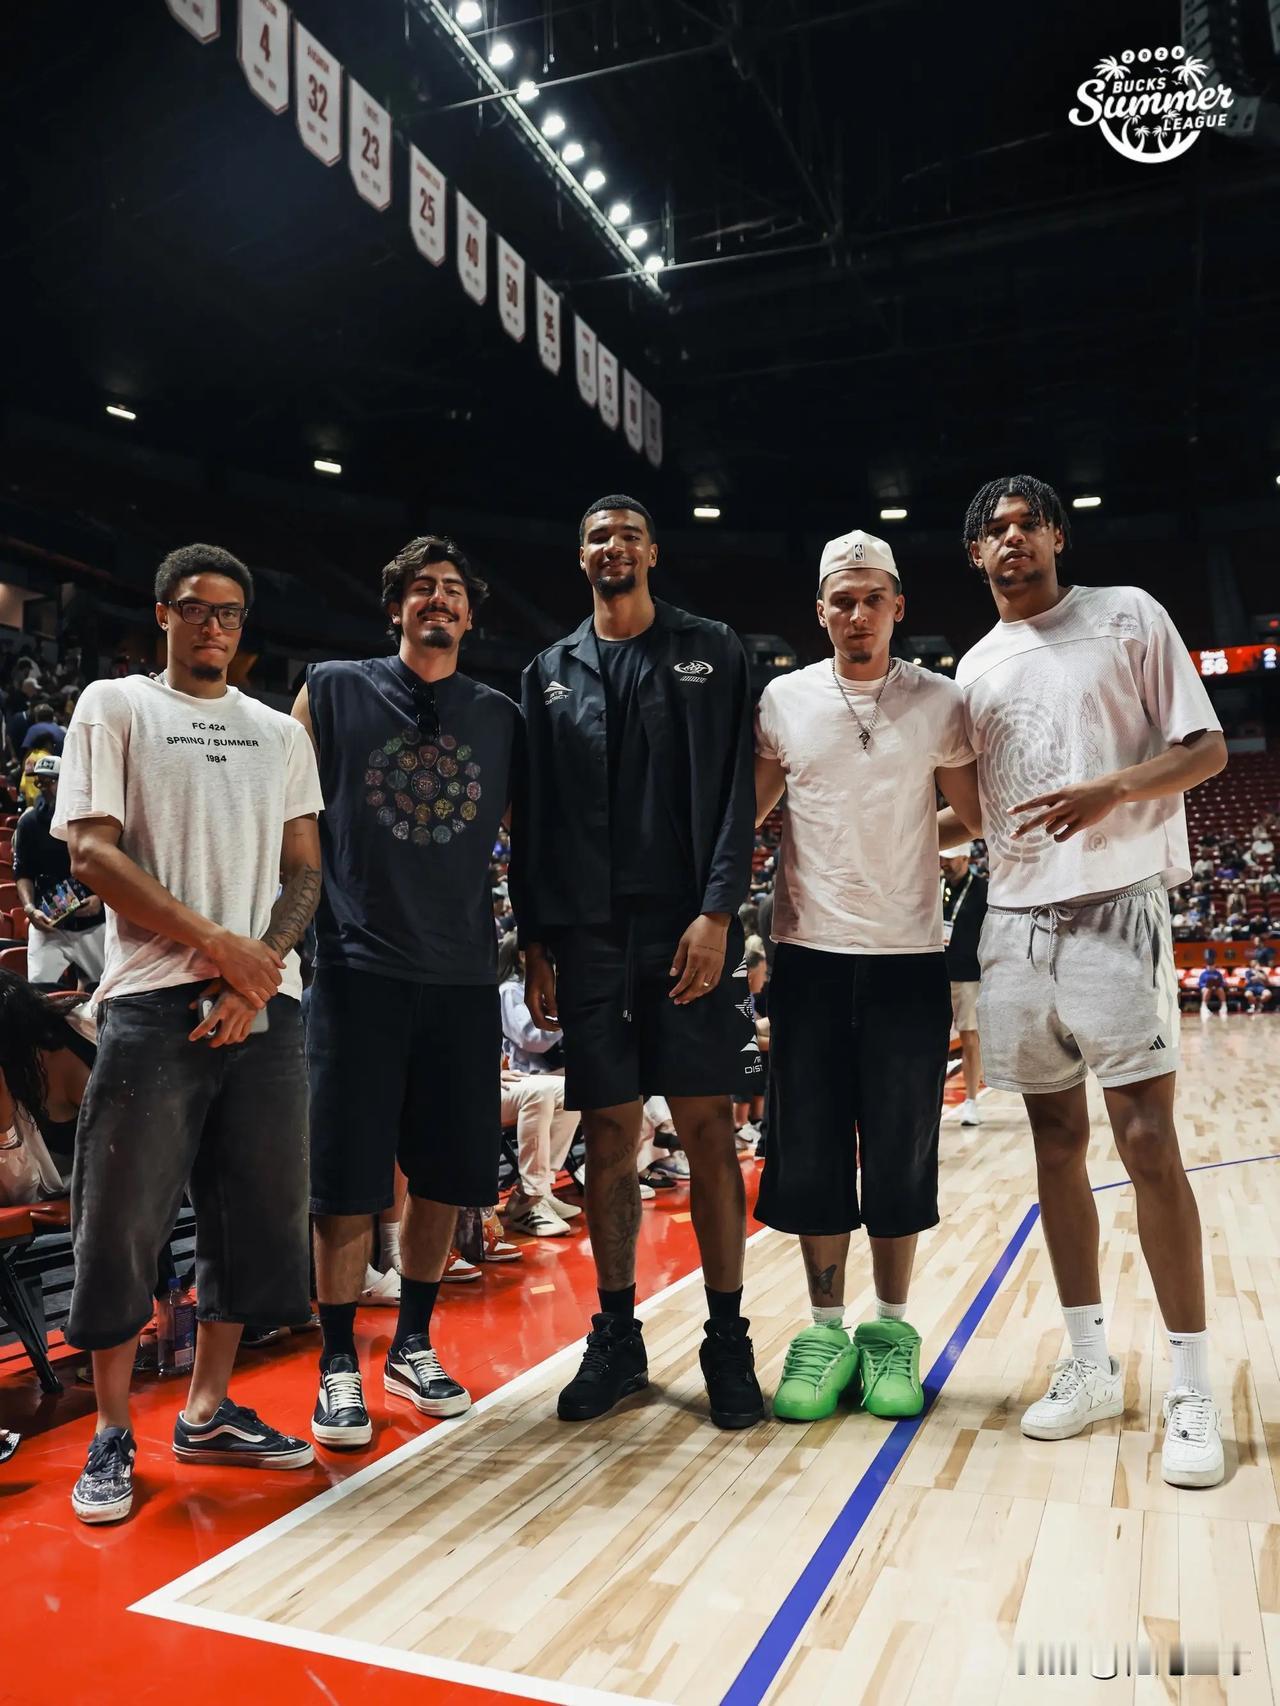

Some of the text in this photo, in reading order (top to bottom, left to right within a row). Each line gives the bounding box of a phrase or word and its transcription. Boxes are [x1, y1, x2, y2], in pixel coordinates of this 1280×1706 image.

[259, 23, 271, 63] 4
[308, 74, 328, 122] 32
[362, 126, 380, 171] 23
[419, 187, 435, 228] 25
[166, 736, 205, 745] SPRING
[213, 739, 260, 748] SUMMER
[192, 722, 227, 732] FC 424
[206, 754, 227, 763] 1984
